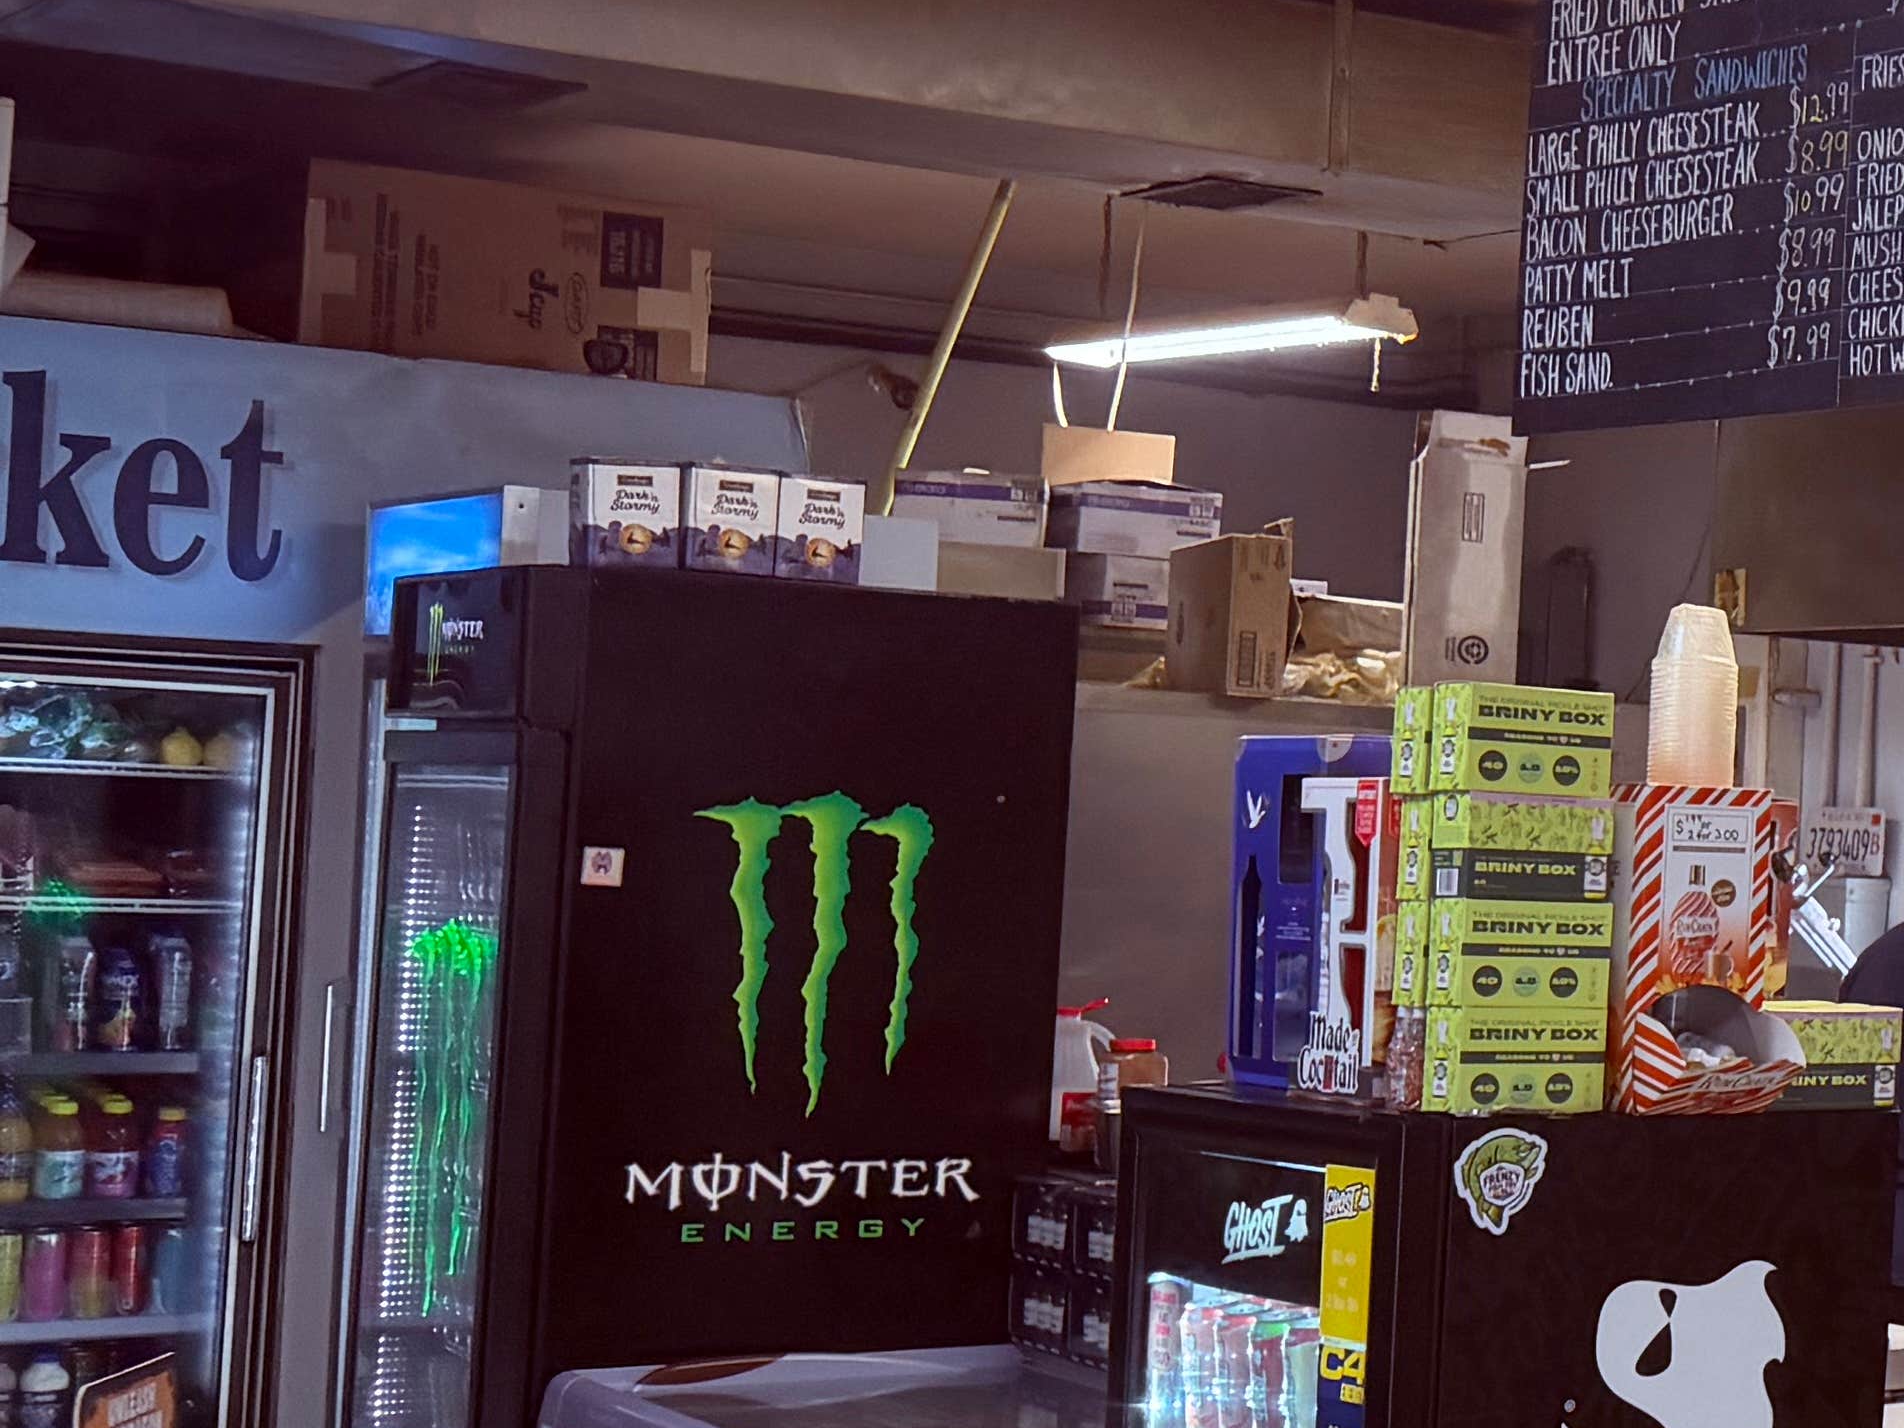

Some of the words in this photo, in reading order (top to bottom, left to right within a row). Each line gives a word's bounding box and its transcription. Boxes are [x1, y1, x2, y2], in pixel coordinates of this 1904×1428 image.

[1694, 44, 1808, 100] SANDWICHES
[1529, 128, 1581, 176] LARGE
[1587, 120, 1641, 165] PHILLY
[1648, 101, 1760, 156] CHEESESTEAK
[1856, 159, 1904, 199] FRIED
[1526, 217, 1587, 260] BACON
[1601, 194, 1733, 253] CHEESEBURGER
[1525, 262, 1576, 304] PATTY
[1582, 258, 1633, 299] MELT
[1522, 305, 1594, 349] REUBEN
[1479, 704, 1555, 721] BRINY
[1559, 711, 1606, 726] BOX
[680, 1217, 925, 1243] ENERGY
[1221, 1194, 1293, 1264] GHOST
[1320, 1347, 1365, 1384] C4
